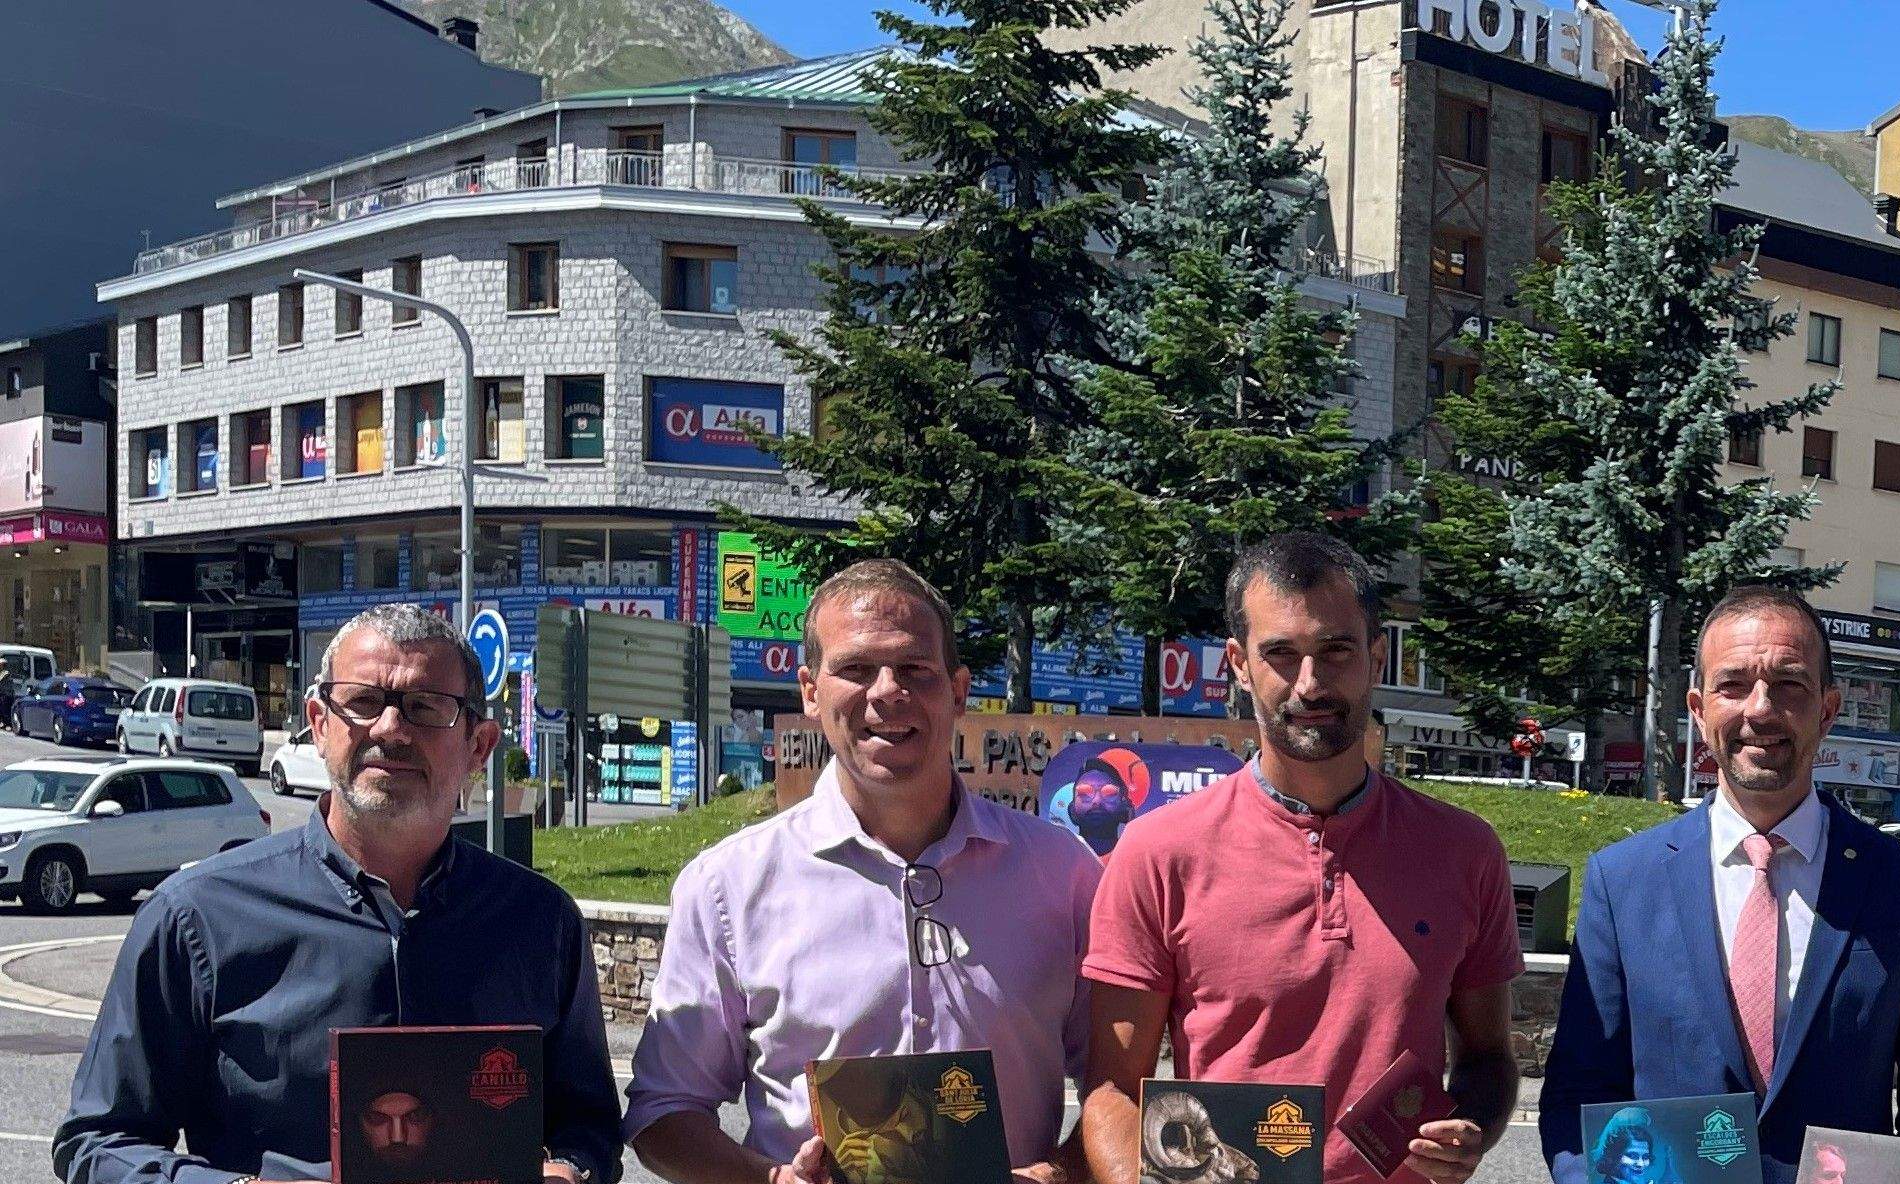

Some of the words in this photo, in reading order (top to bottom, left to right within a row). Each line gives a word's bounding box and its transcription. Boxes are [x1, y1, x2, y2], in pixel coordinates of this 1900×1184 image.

[1417, 0, 1608, 85] HOTEL
[1833, 619, 1871, 639] STRIKE
[983, 728, 1052, 777] PAS
[1258, 1124, 1270, 1134] LA
[1270, 1124, 1311, 1135] MASSANA
